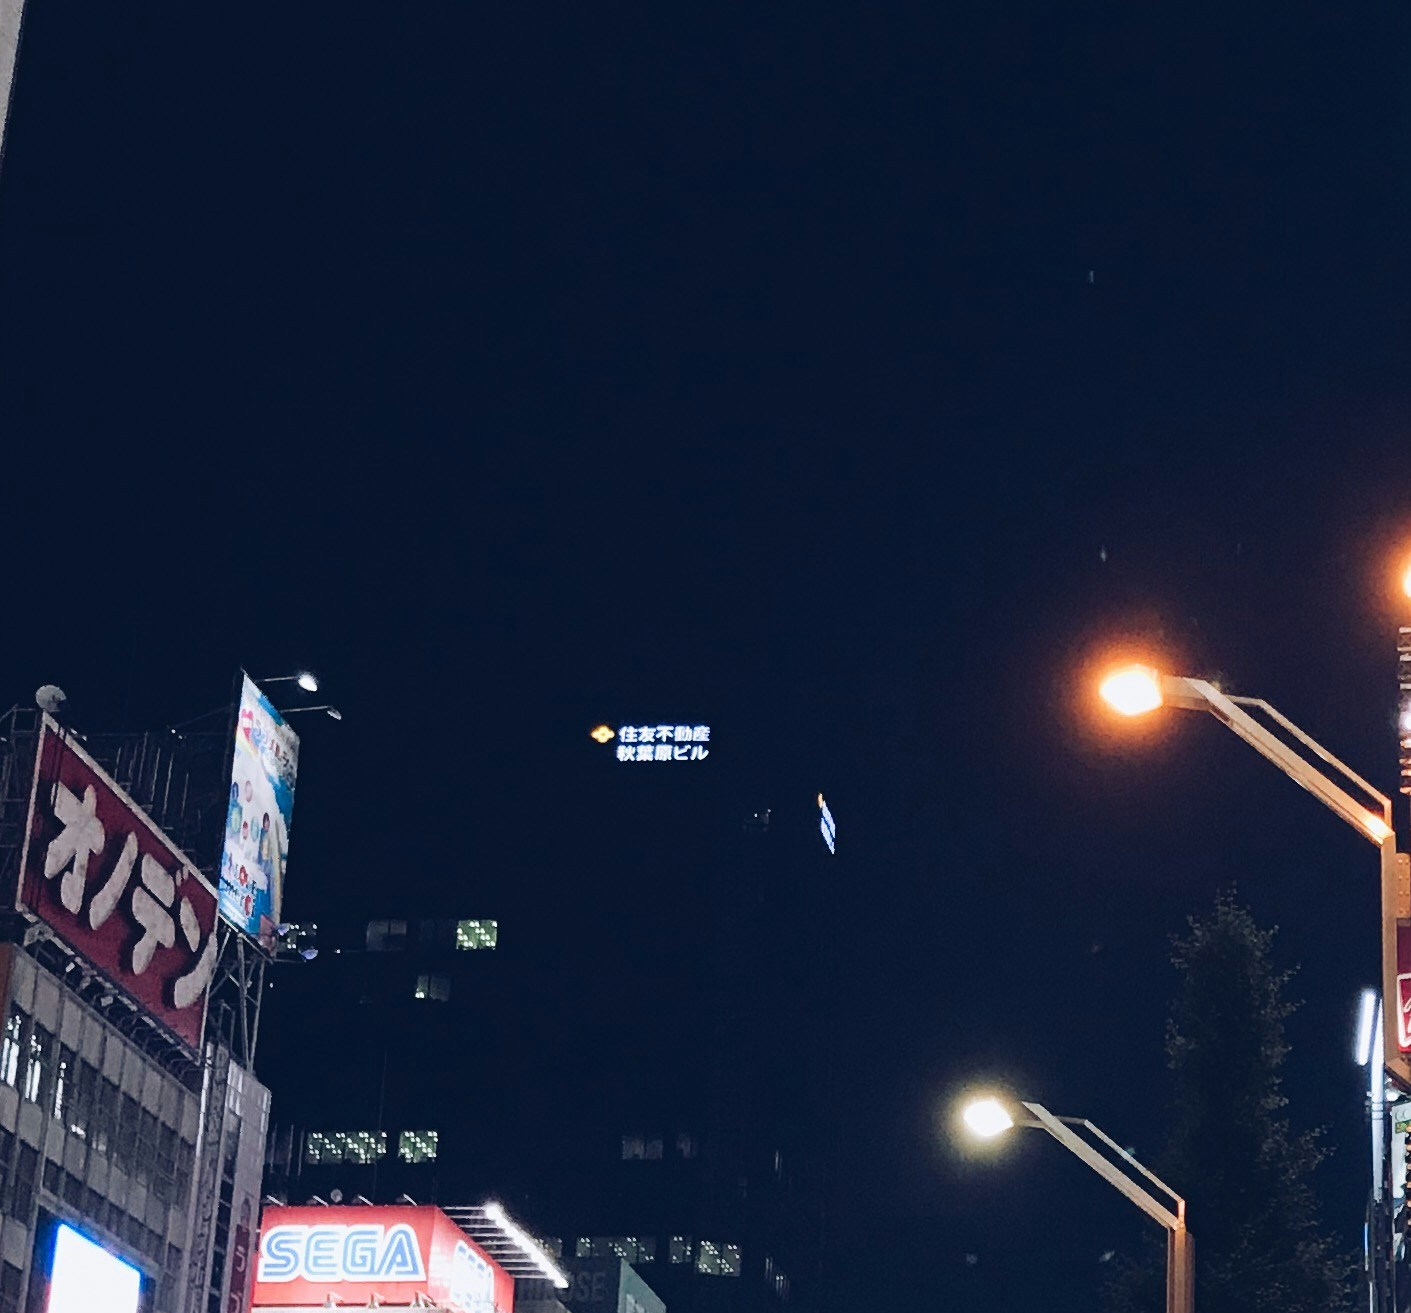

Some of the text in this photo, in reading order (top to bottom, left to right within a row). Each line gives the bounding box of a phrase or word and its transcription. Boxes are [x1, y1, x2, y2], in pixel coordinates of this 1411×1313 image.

[617, 744, 710, 761] 秋葉原ビル
[619, 725, 710, 742] 住友不動産
[45, 779, 217, 1010] オノデン
[258, 1223, 427, 1283] SEGA
